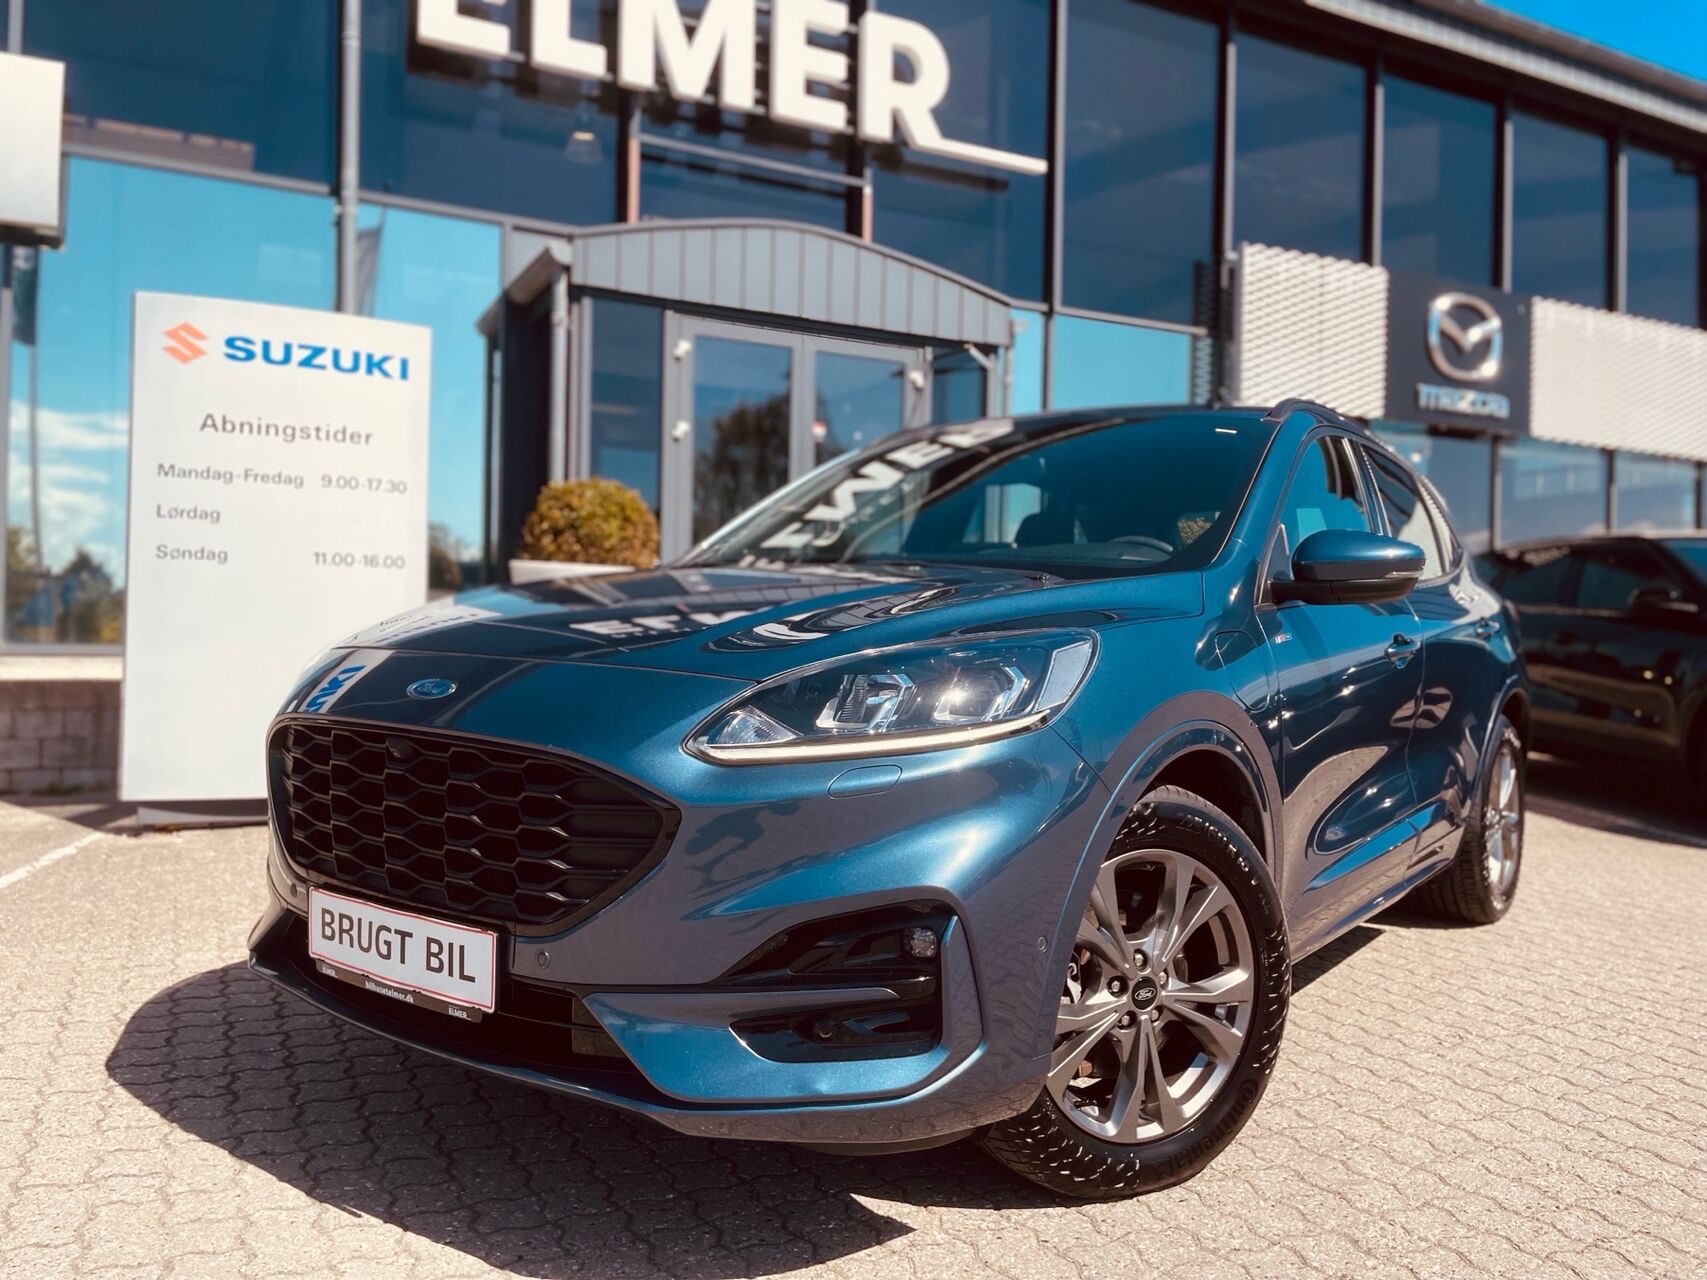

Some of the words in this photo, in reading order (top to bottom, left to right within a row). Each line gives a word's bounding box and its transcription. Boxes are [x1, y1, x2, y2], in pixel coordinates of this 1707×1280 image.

[223, 336, 409, 381] SUZUKI
[199, 412, 374, 445] Abningstider
[156, 503, 221, 525] Lørdag
[155, 544, 229, 565] Søndag
[320, 907, 414, 965] BRUGT
[426, 936, 476, 983] BIL
[1137, 988, 1156, 1000] Ford
[448, 1007, 471, 1020] ELMER
